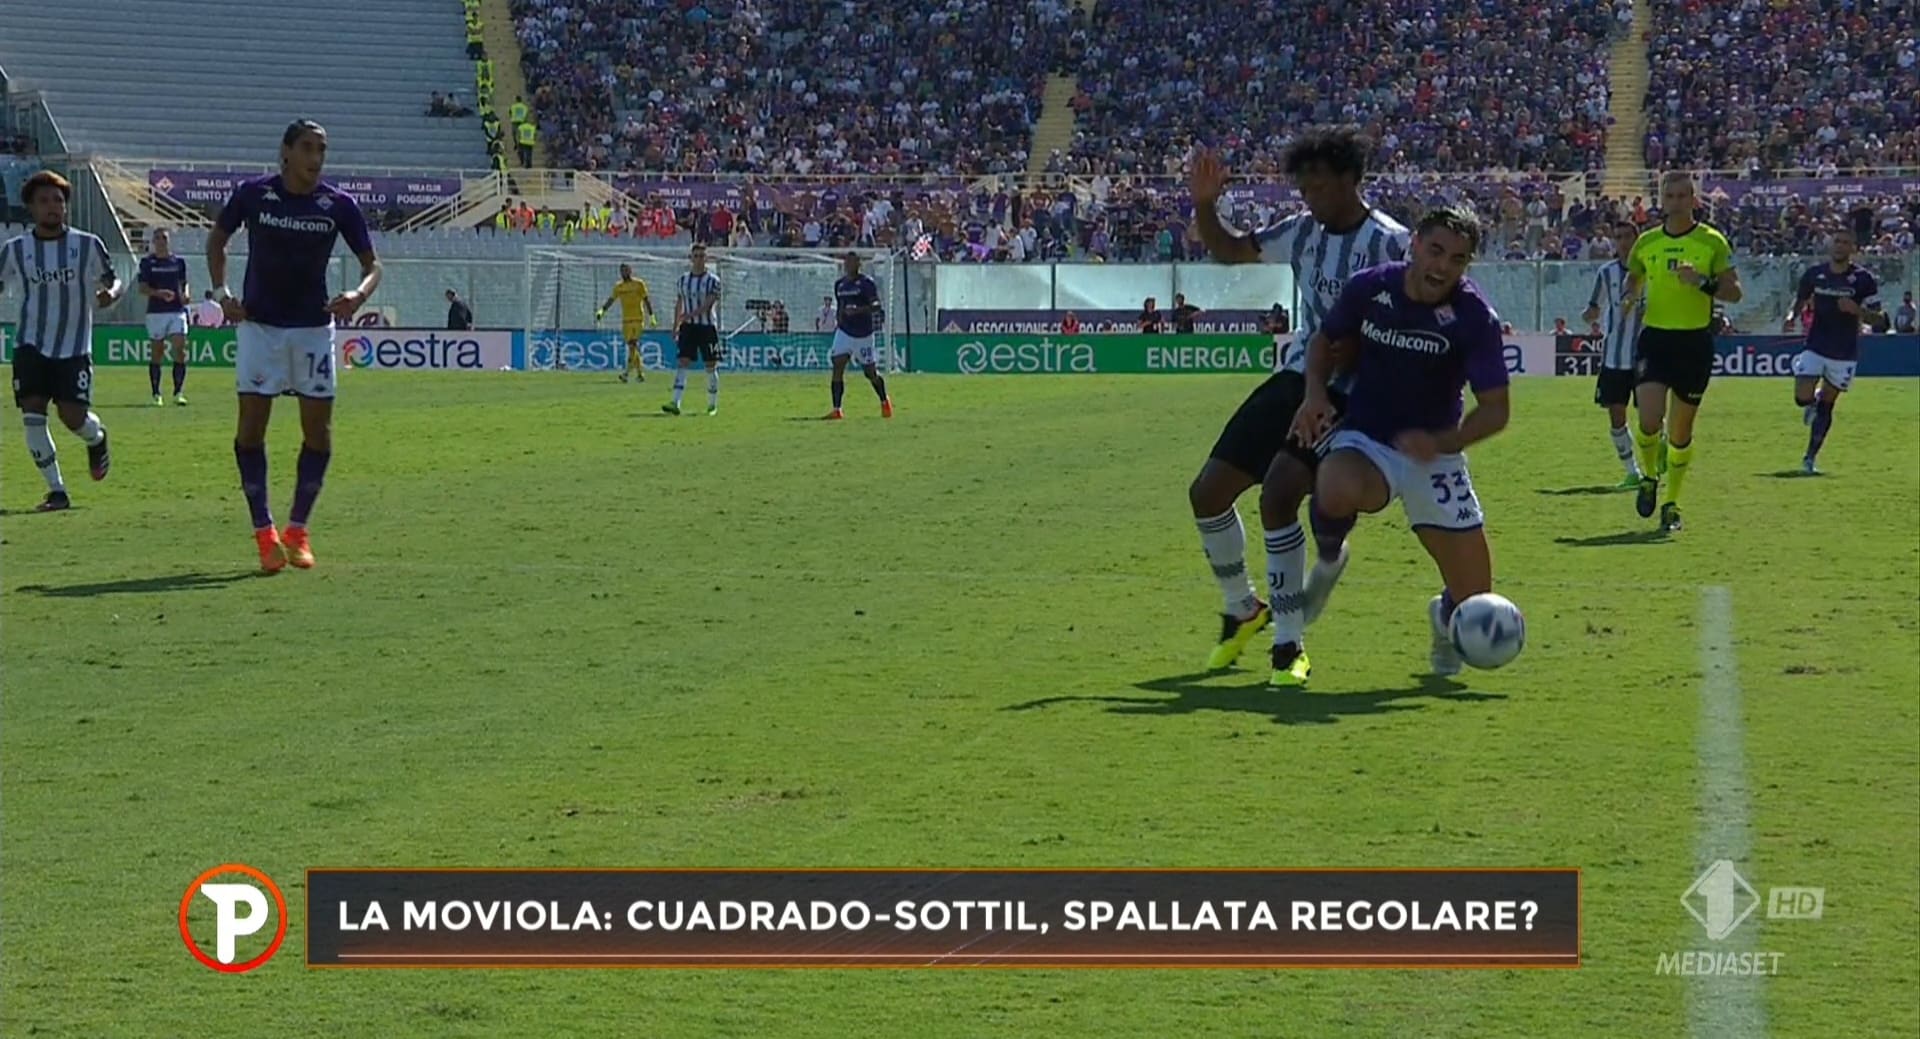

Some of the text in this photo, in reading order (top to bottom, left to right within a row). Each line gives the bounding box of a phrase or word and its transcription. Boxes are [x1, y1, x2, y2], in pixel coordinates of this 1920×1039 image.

[186, 190, 222, 201] TRENTO
[259, 212, 328, 232] Mediacom
[30, 266, 76, 284] Jeep
[1361, 319, 1440, 354] Mediacom
[376, 333, 483, 368] estra
[990, 337, 1097, 372] estra
[1146, 346, 1252, 369] ENERGIA
[306, 352, 331, 380] 14
[77, 371, 89, 390] 8
[1430, 471, 1473, 504] 33
